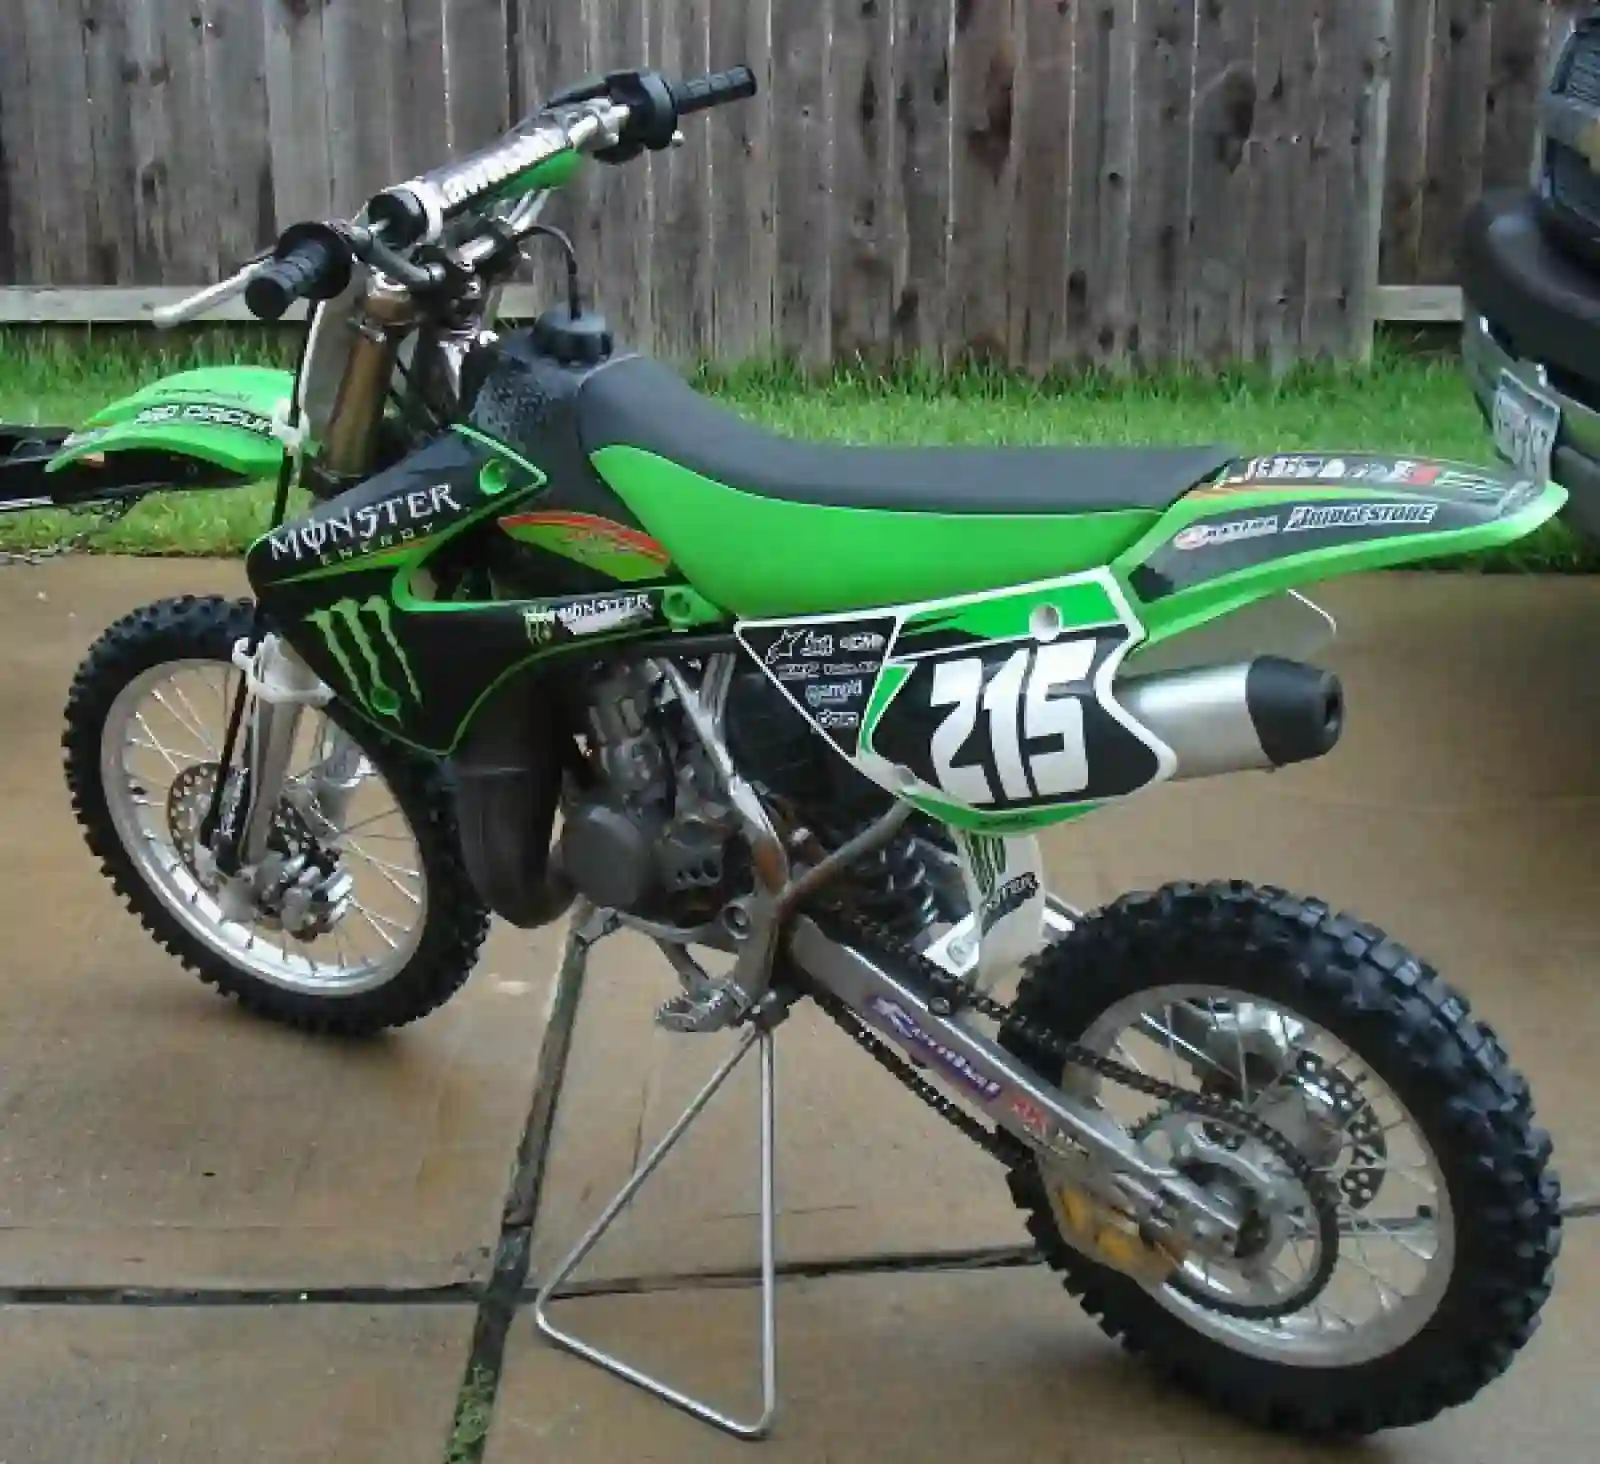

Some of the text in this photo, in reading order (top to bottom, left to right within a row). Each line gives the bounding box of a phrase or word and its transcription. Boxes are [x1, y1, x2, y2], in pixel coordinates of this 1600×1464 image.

[268, 482, 462, 561] MONSTER
[1286, 503, 1437, 531] BRIDGESTONE
[929, 638, 1097, 803] 215
